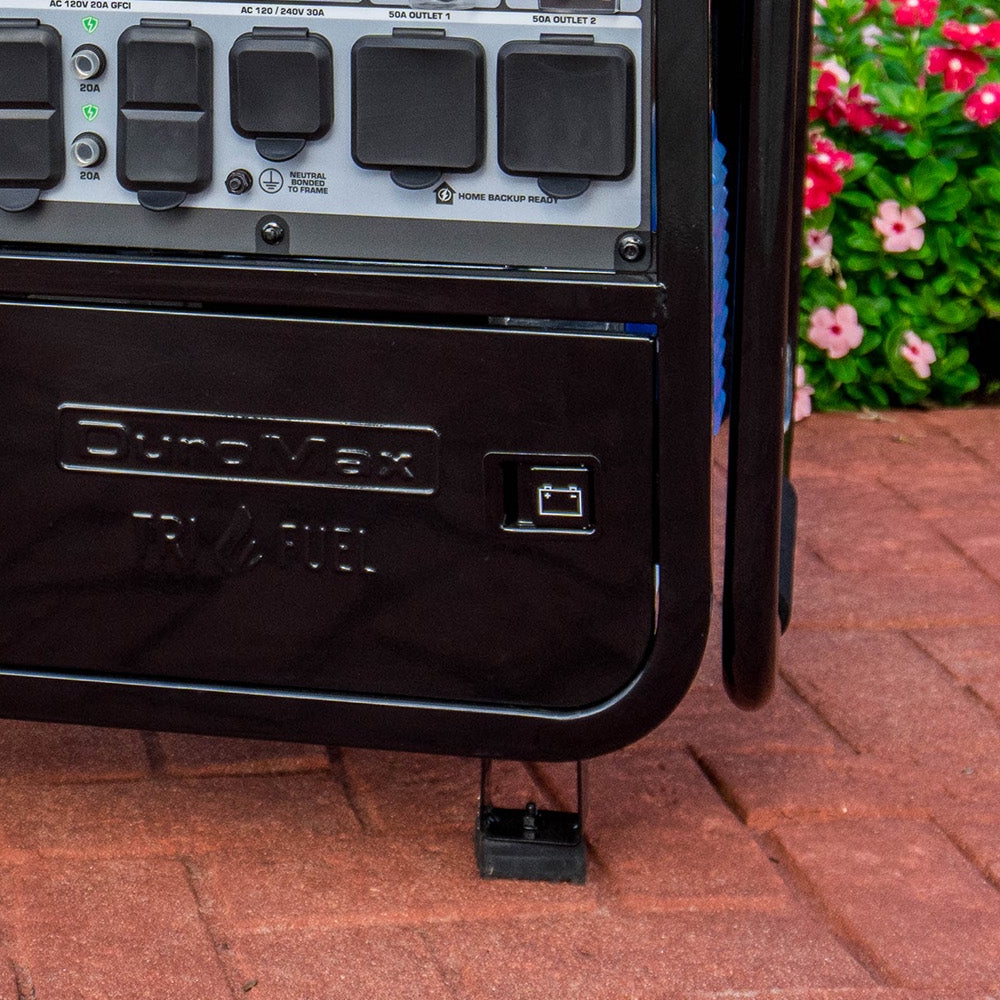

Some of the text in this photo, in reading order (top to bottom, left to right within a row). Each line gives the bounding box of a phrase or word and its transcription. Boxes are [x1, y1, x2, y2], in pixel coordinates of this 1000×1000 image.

[49, 0, 131, 10] AC 120V 20A GFCI
[240, 6, 325, 16] AC 120 / 240V 30A
[388, 11, 451, 20] 50A OUTLET 1
[532, 15, 597, 25] 50A OUTLET 2
[79, 83, 100, 93] 20A
[79, 171, 100, 180] 20A
[289, 171, 326, 180] NEUTRAL
[291, 178, 326, 187] BONDED
[288, 185, 329, 195] TO FRAME
[458, 192, 486, 201] HOME
[488, 193, 526, 203] BACKUP
